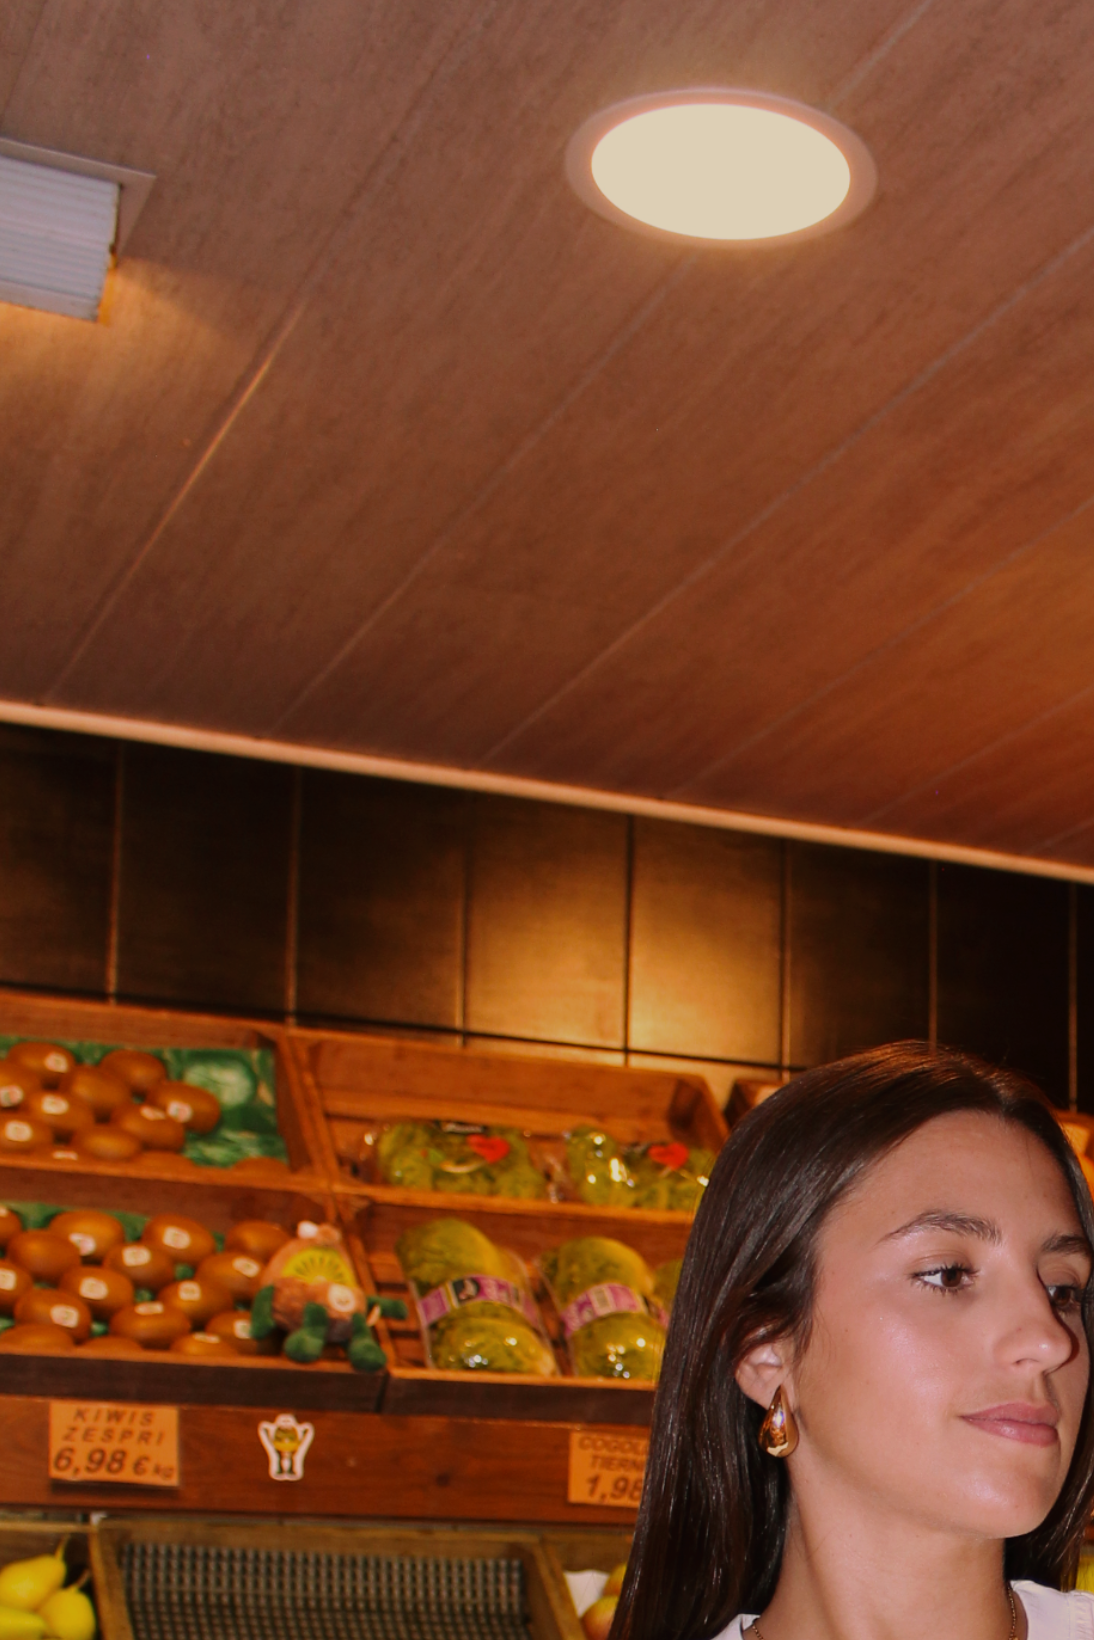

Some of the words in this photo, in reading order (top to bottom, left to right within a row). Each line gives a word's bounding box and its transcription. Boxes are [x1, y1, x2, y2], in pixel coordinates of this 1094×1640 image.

[73, 1408, 156, 1426] KIWIS
[62, 1427, 165, 1446] ZESPRI
[53, 1447, 127, 1476] 6,98
